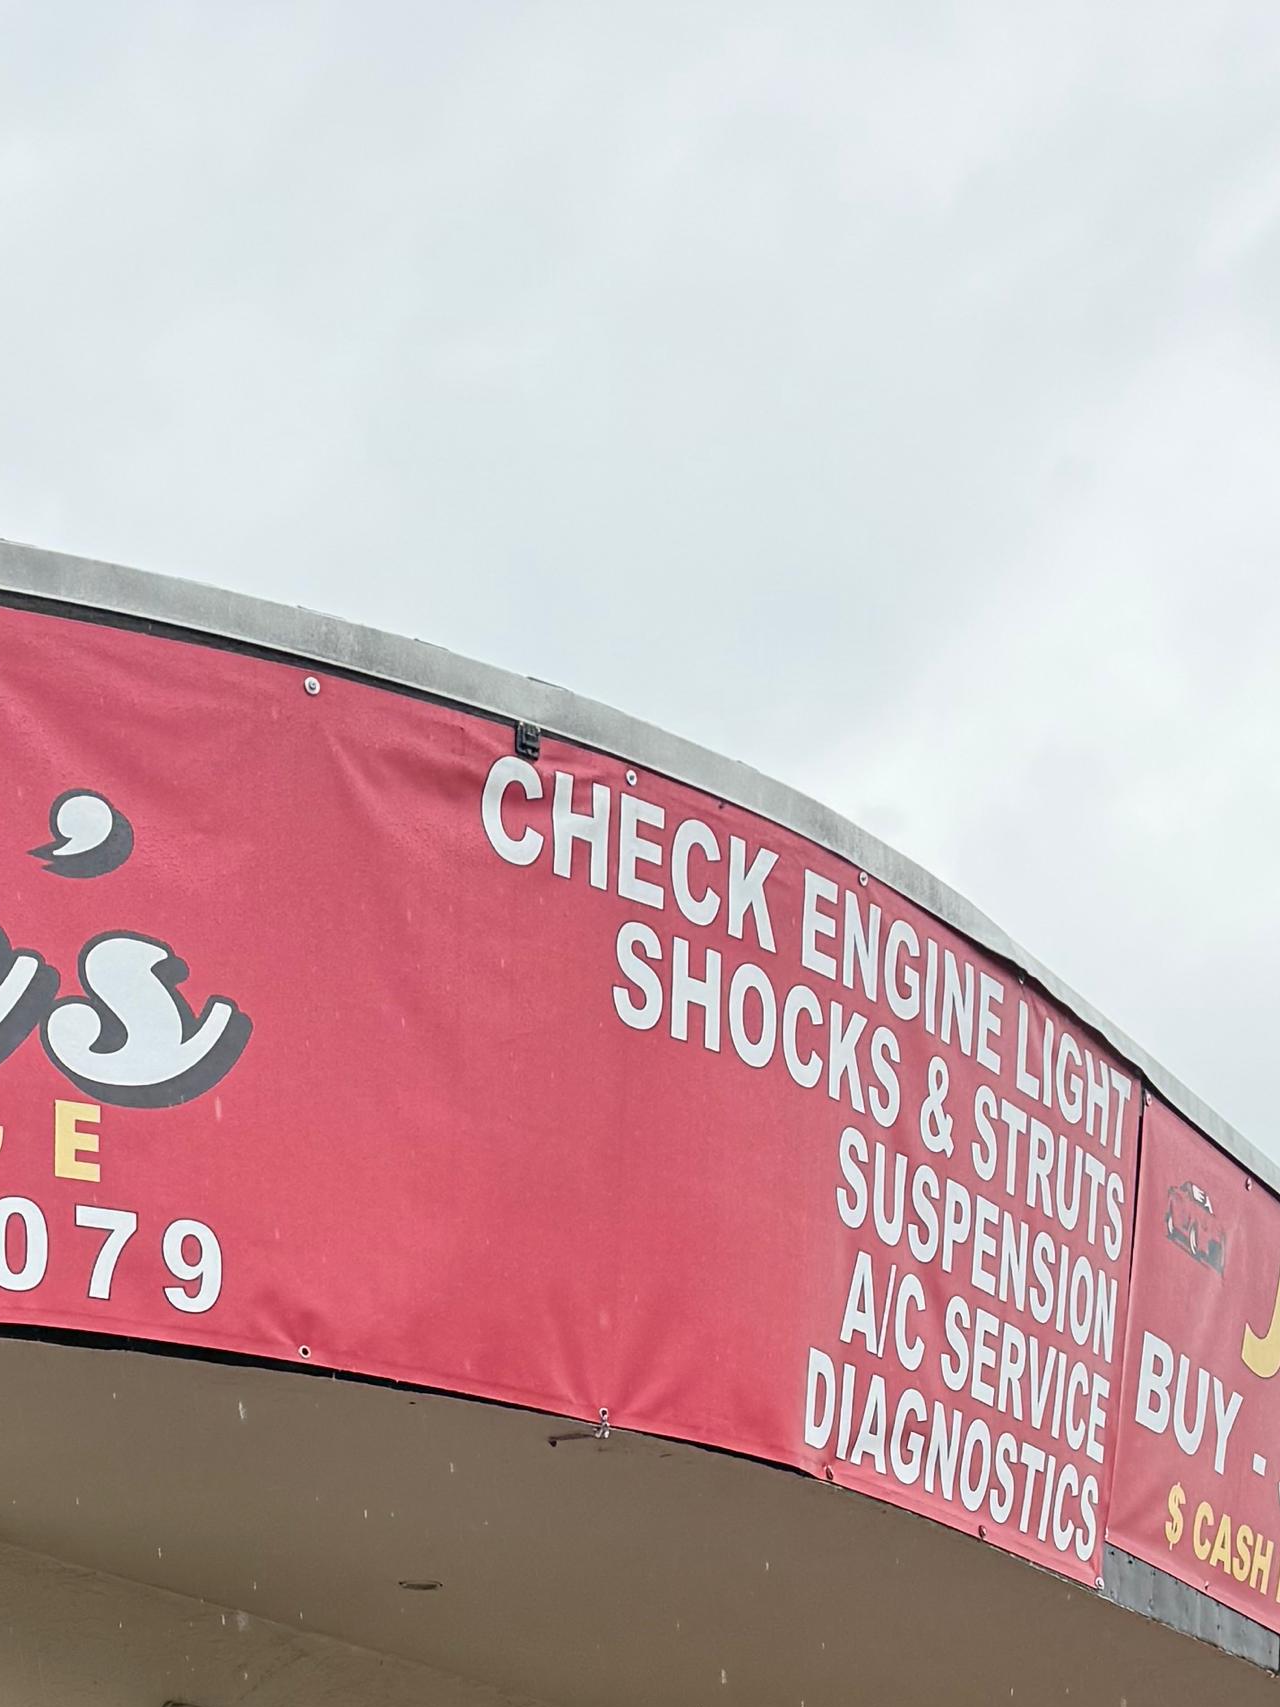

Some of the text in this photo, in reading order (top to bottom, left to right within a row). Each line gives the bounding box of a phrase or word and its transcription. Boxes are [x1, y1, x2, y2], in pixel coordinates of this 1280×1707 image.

[480, 756, 1132, 1159] CHECK ENGINE LIGHT
[613, 921, 1125, 1261] SHOCKS & STRUTS
[836, 1127, 1118, 1365] SUSPENSION
[803, 1347, 1099, 1561] DIAGNOSTICS
[840, 1252, 1110, 1464] A/C SERVICE
[1134, 1331, 1243, 1476] BUY
[1192, 1507, 1271, 1596] CASH
